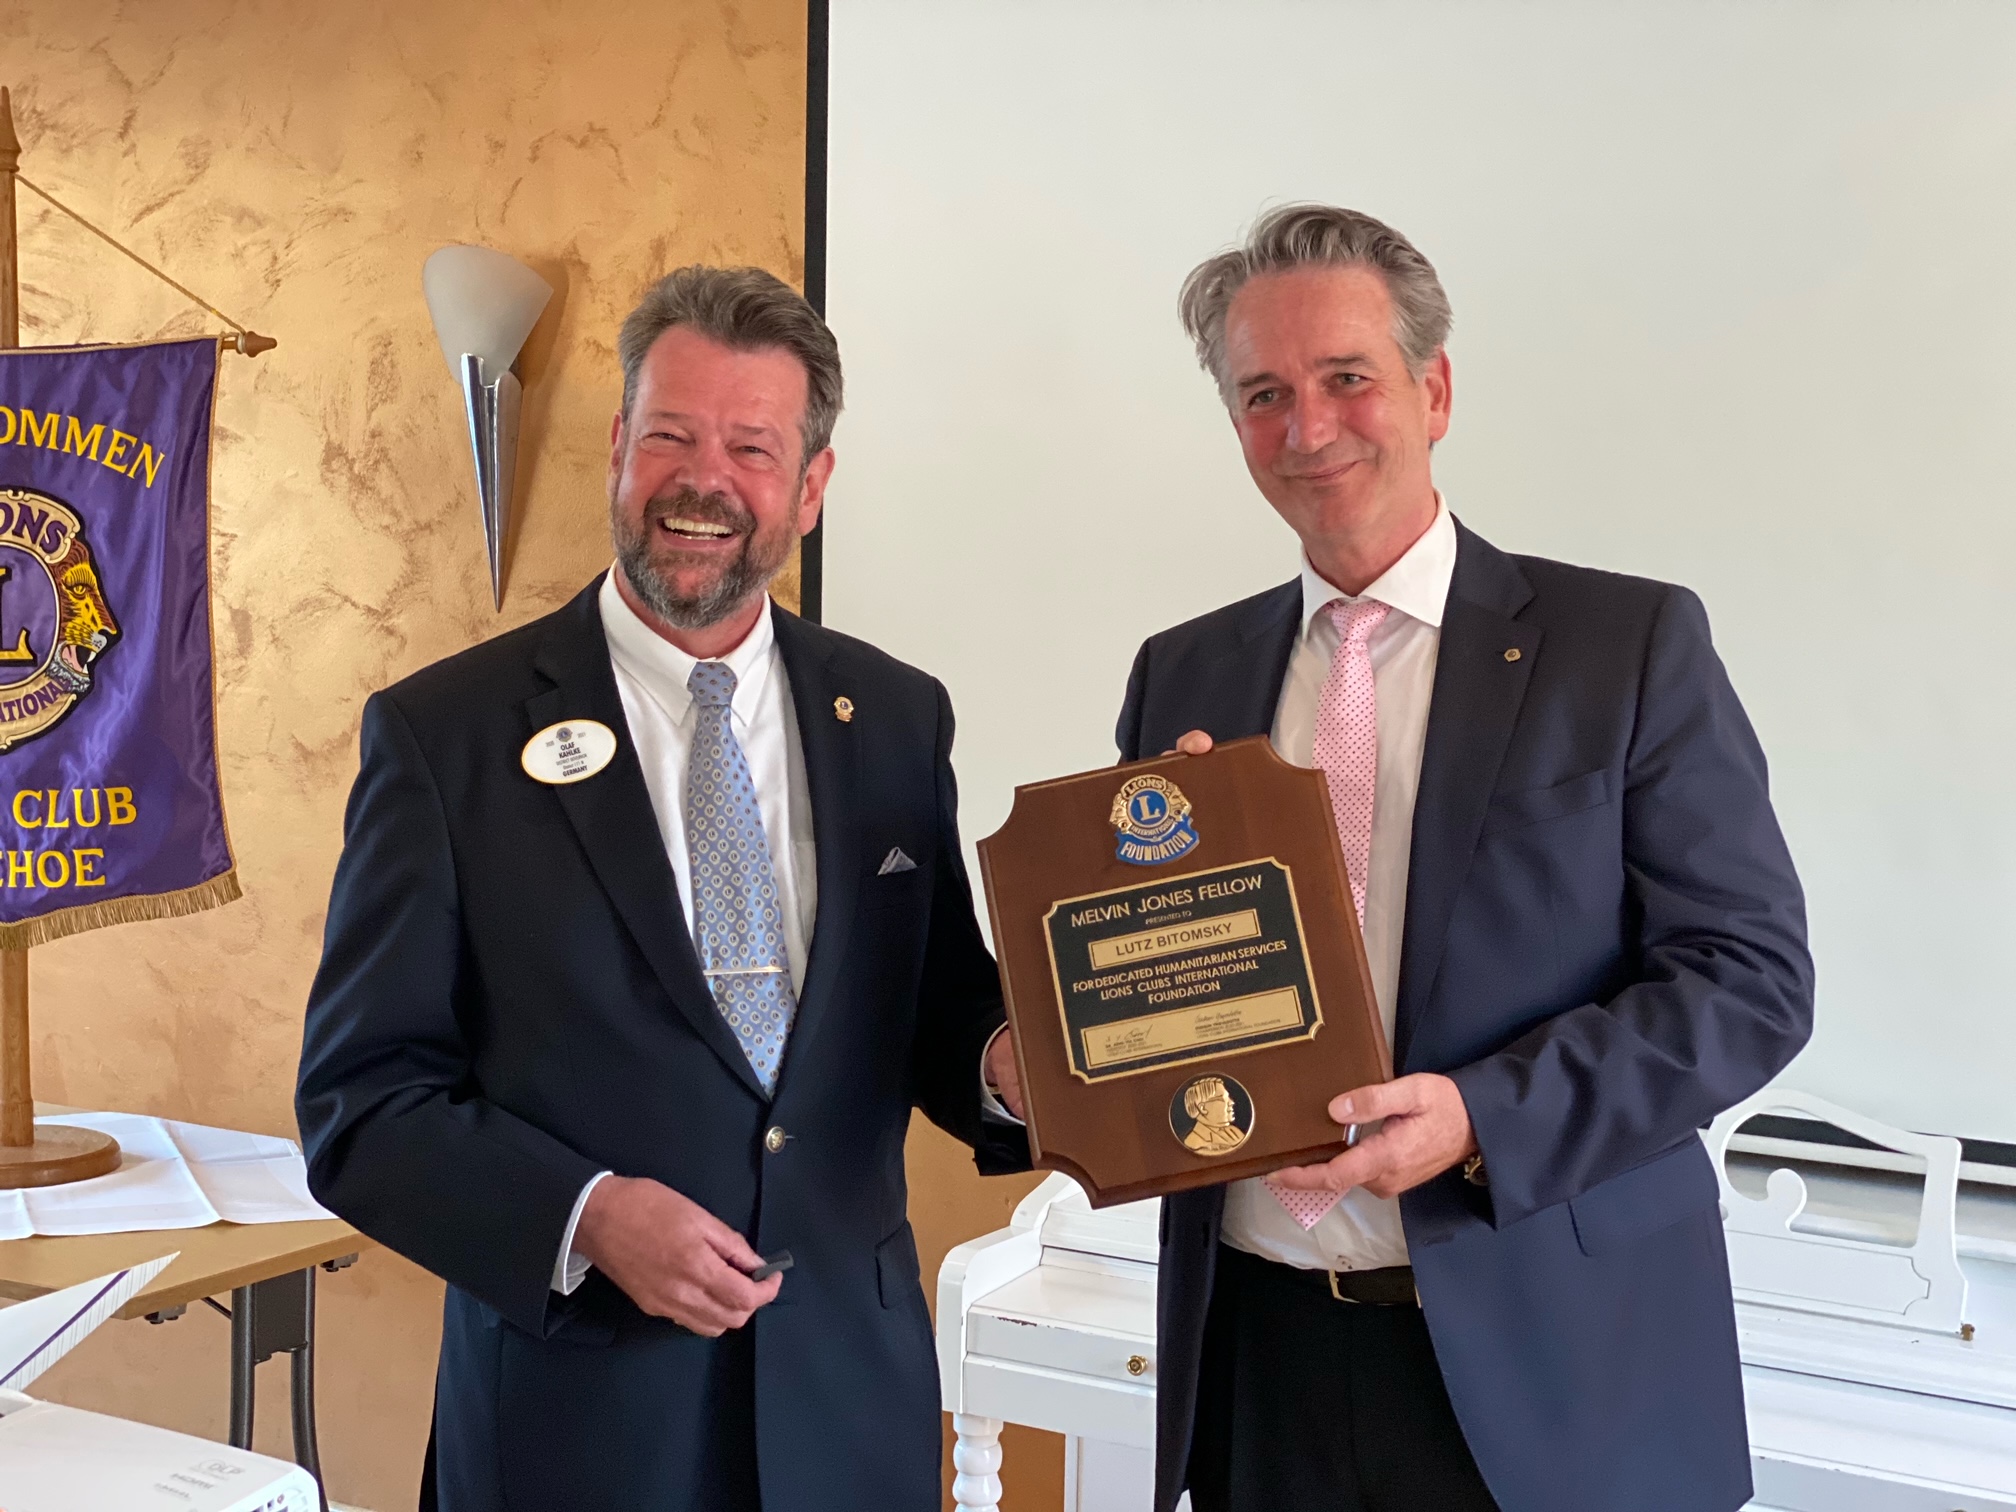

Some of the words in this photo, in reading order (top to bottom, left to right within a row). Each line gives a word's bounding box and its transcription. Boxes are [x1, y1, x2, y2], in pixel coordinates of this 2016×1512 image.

[558, 747, 581, 759] KAHLKE
[560, 741, 575, 751] OLAF
[562, 764, 588, 777] GERMANY
[1124, 778, 1163, 797] LIONS
[12, 786, 137, 829] CLUB
[1136, 795, 1161, 821] L
[1120, 829, 1193, 861] FOUNDATION
[0, 848, 106, 888] HOE
[1071, 901, 1131, 927] MELVIN
[1137, 889, 1193, 914] JONES
[1199, 874, 1263, 900] FELLOW
[1145, 912, 1181, 925] PRESENTED
[1182, 910, 1192, 918] TO
[1115, 937, 1153, 956] LUTZ
[1156, 922, 1232, 948] BITOMSKY
[1073, 980, 1094, 993] FOR
[1095, 967, 1153, 988] DEDICATED
[1155, 950, 1237, 975] HUMANITARIAN
[1238, 940, 1287, 959] SERVICES
[1100, 985, 1133, 1000] LIONS
[1137, 977, 1171, 993] CLUBS
[1175, 960, 1259, 985] INTERNATIONAL
[1148, 981, 1220, 1004] FOUNDATION
